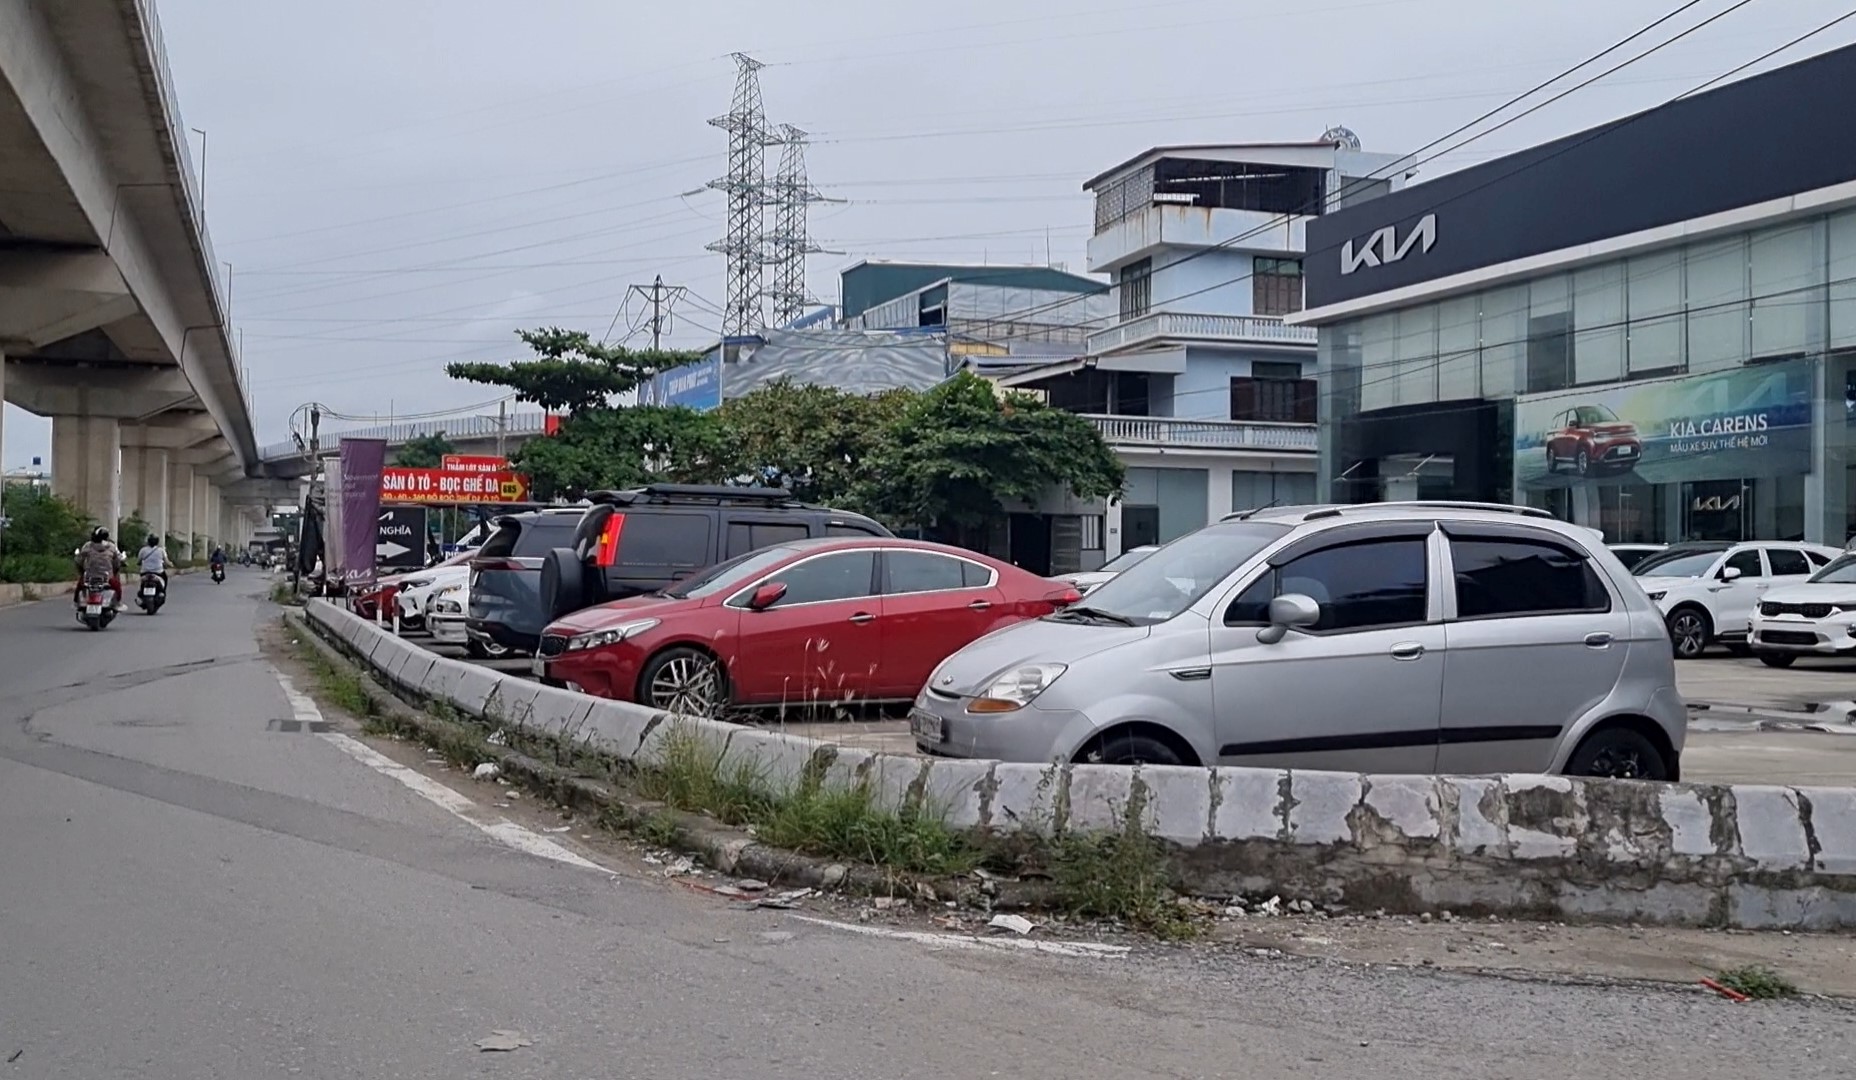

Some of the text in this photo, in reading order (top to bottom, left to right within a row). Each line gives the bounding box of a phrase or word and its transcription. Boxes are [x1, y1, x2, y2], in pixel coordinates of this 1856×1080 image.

[1340, 213, 1437, 275] KIA
[1670, 413, 1767, 439] KIA CARENS
[1690, 441, 1700, 451] XE
[1702, 440, 1718, 451] SUV
[383, 472, 407, 490] SÀN
[408, 474, 415, 490] Ô
[417, 474, 430, 491] TÔ
[440, 477, 460, 494] BỌC
[463, 474, 483, 492] GHẾ
[485, 478, 499, 493] DA
[1692, 495, 1740, 511] KIA
[380, 525, 412, 536] NGHĨA
